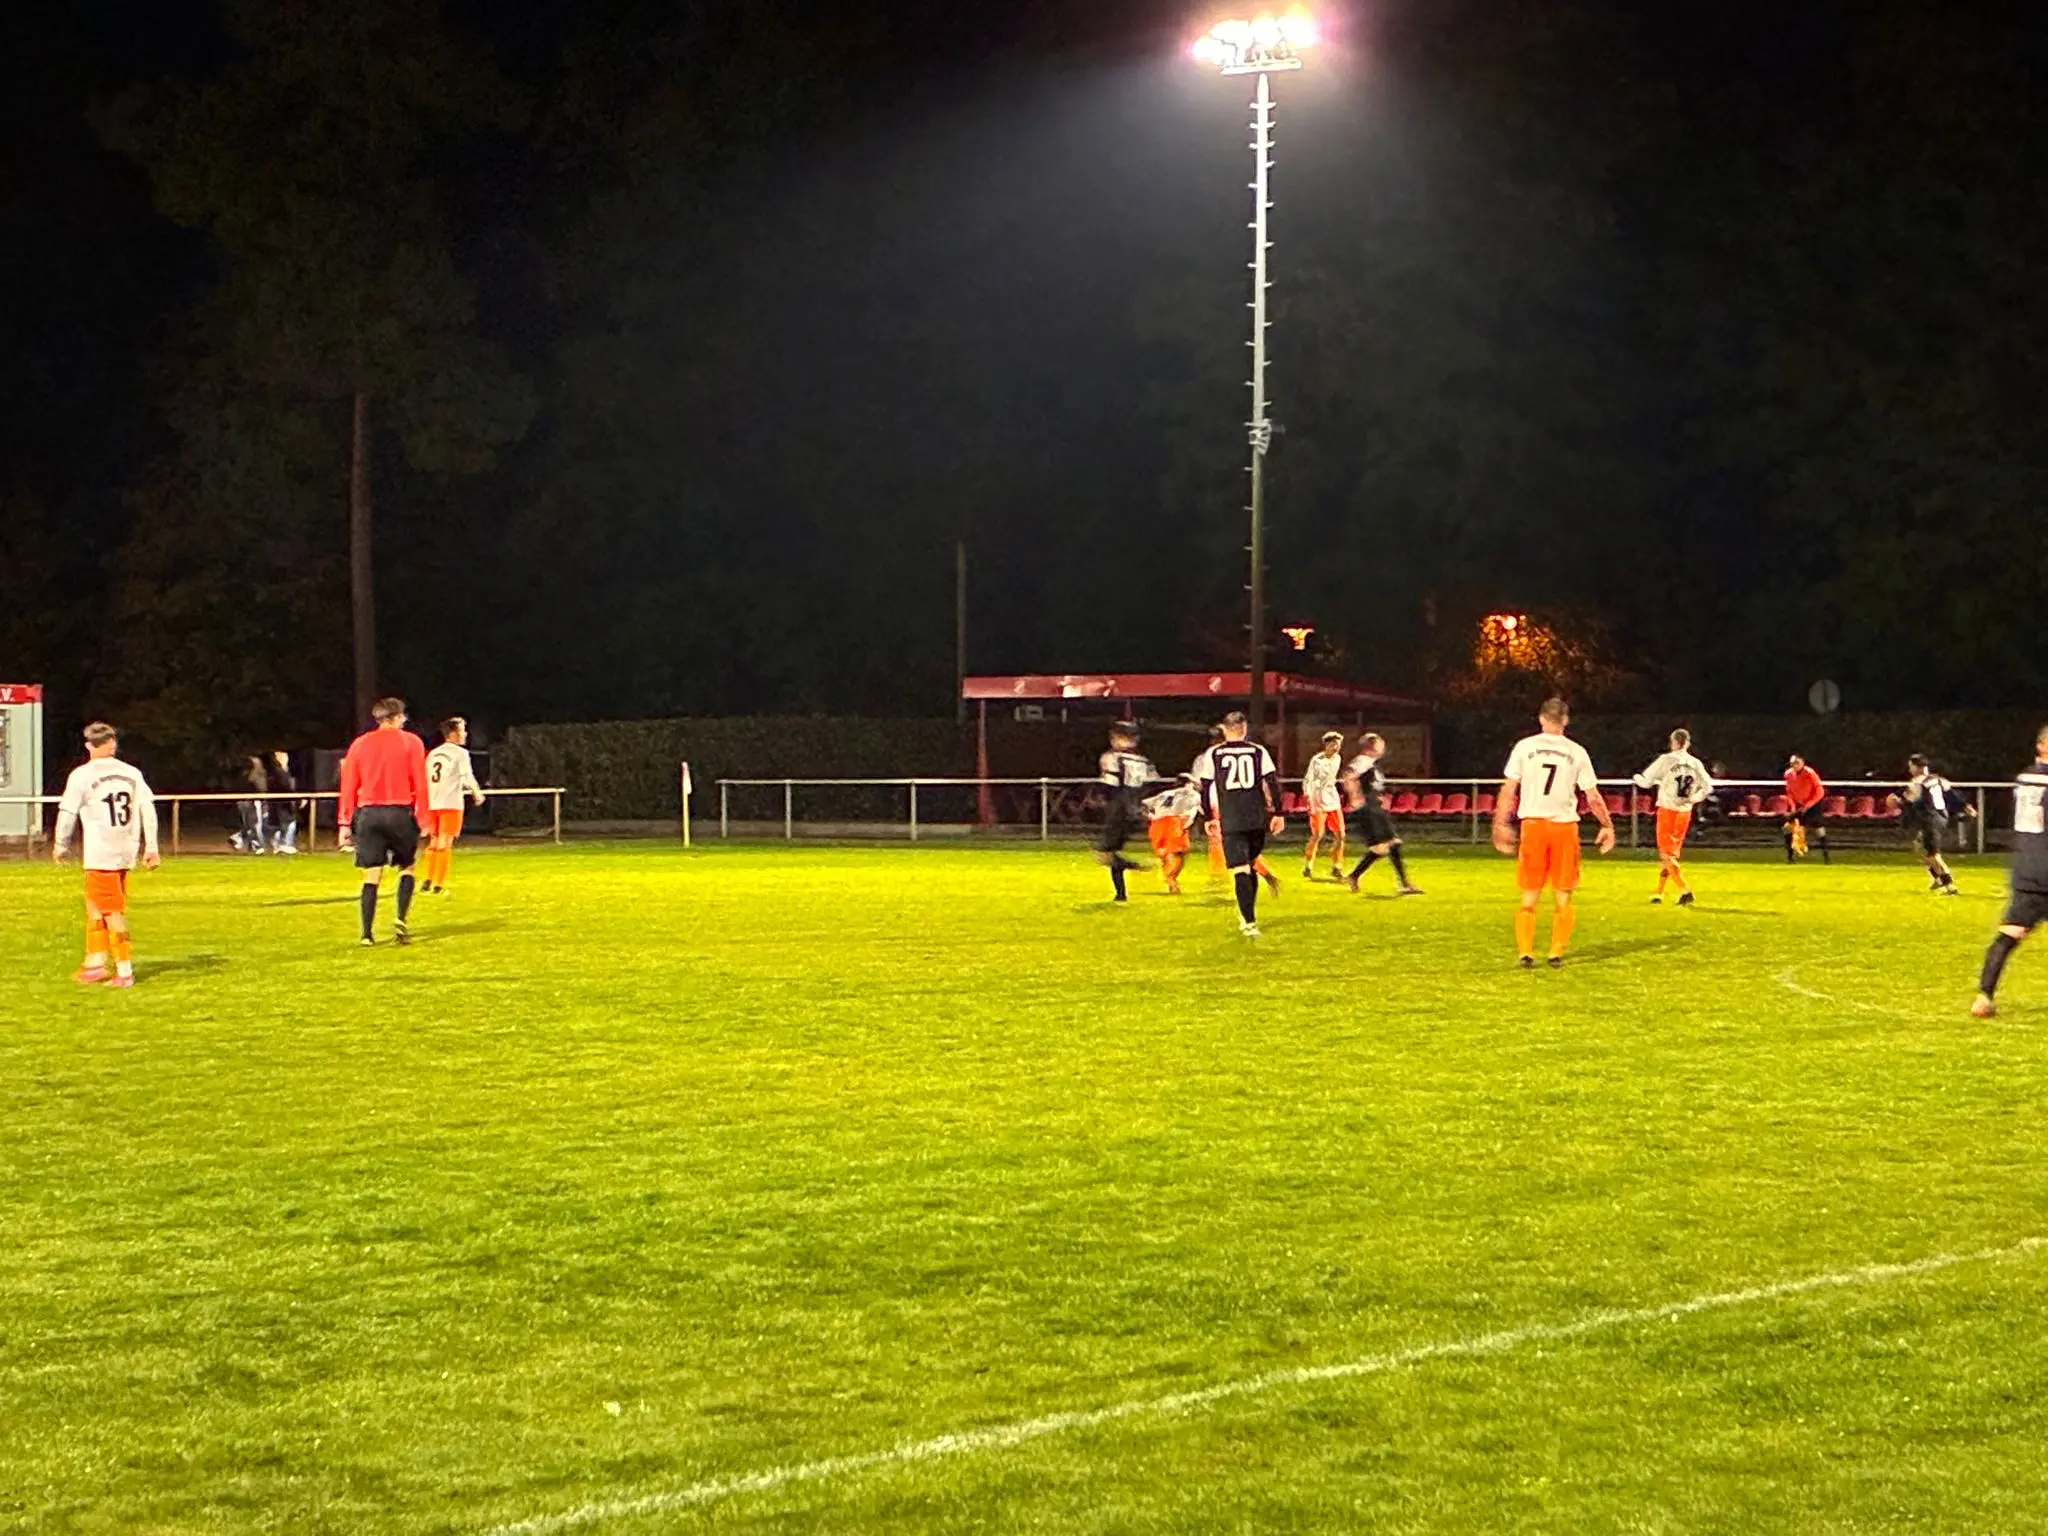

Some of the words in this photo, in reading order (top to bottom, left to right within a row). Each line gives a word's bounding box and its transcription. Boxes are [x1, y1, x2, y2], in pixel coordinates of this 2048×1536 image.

[431, 761, 443, 783] 3
[1221, 754, 1256, 791] 20
[1541, 763, 1558, 796] 7
[101, 791, 131, 827] 13
